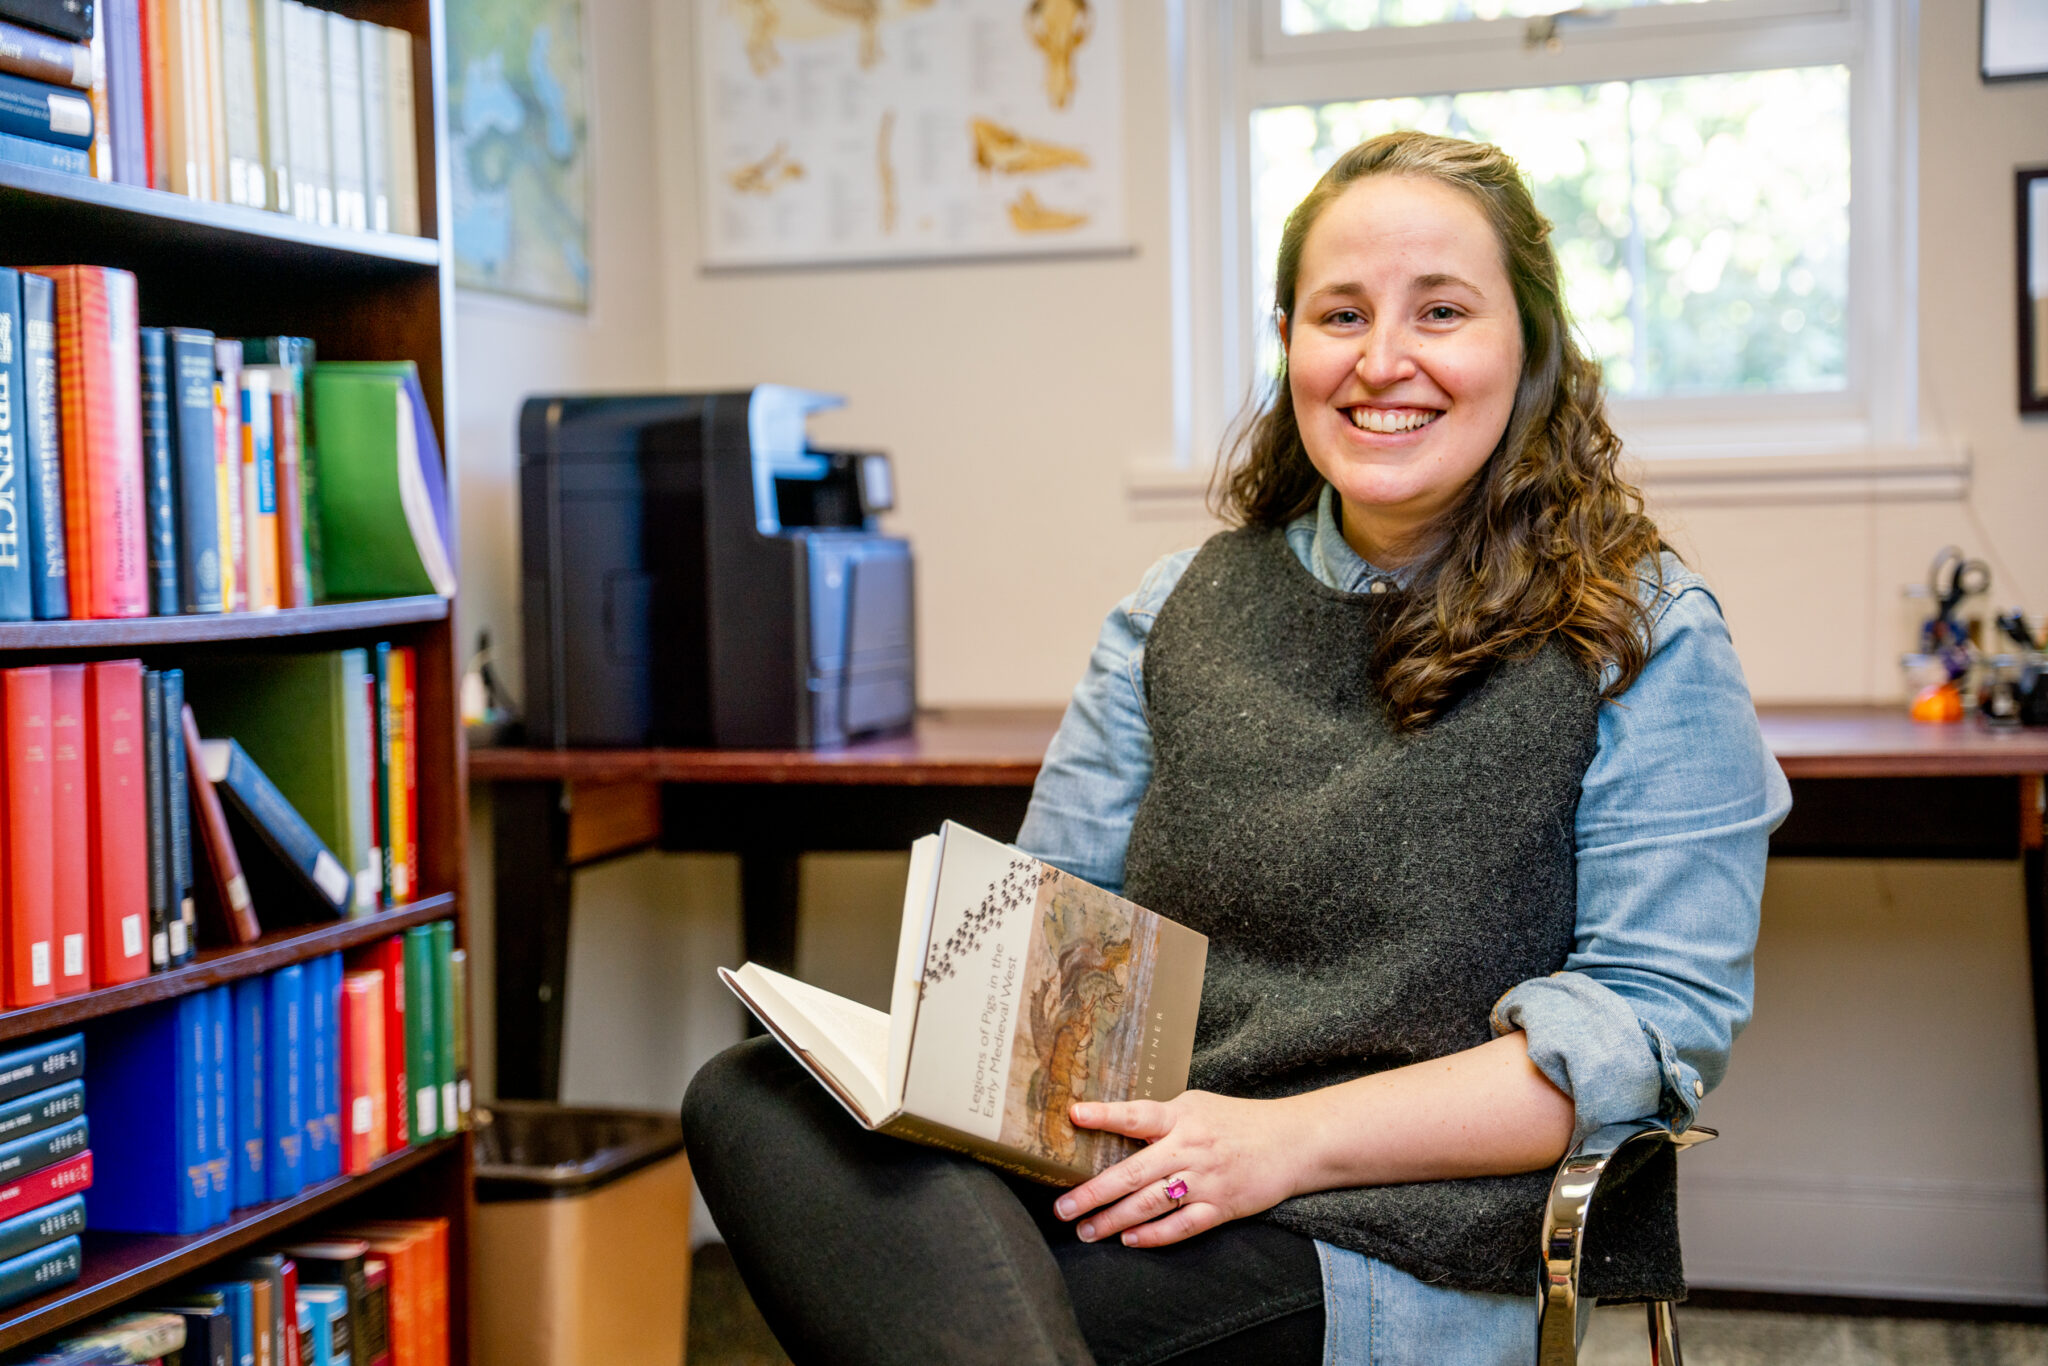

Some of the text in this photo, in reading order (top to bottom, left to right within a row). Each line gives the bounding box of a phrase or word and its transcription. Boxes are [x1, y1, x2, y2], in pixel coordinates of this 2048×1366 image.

[968, 943, 1005, 1114] Legions of Pigs in the
[983, 957, 1018, 1119] Early Medieval West
[1144, 1012, 1163, 1096] KREINER
